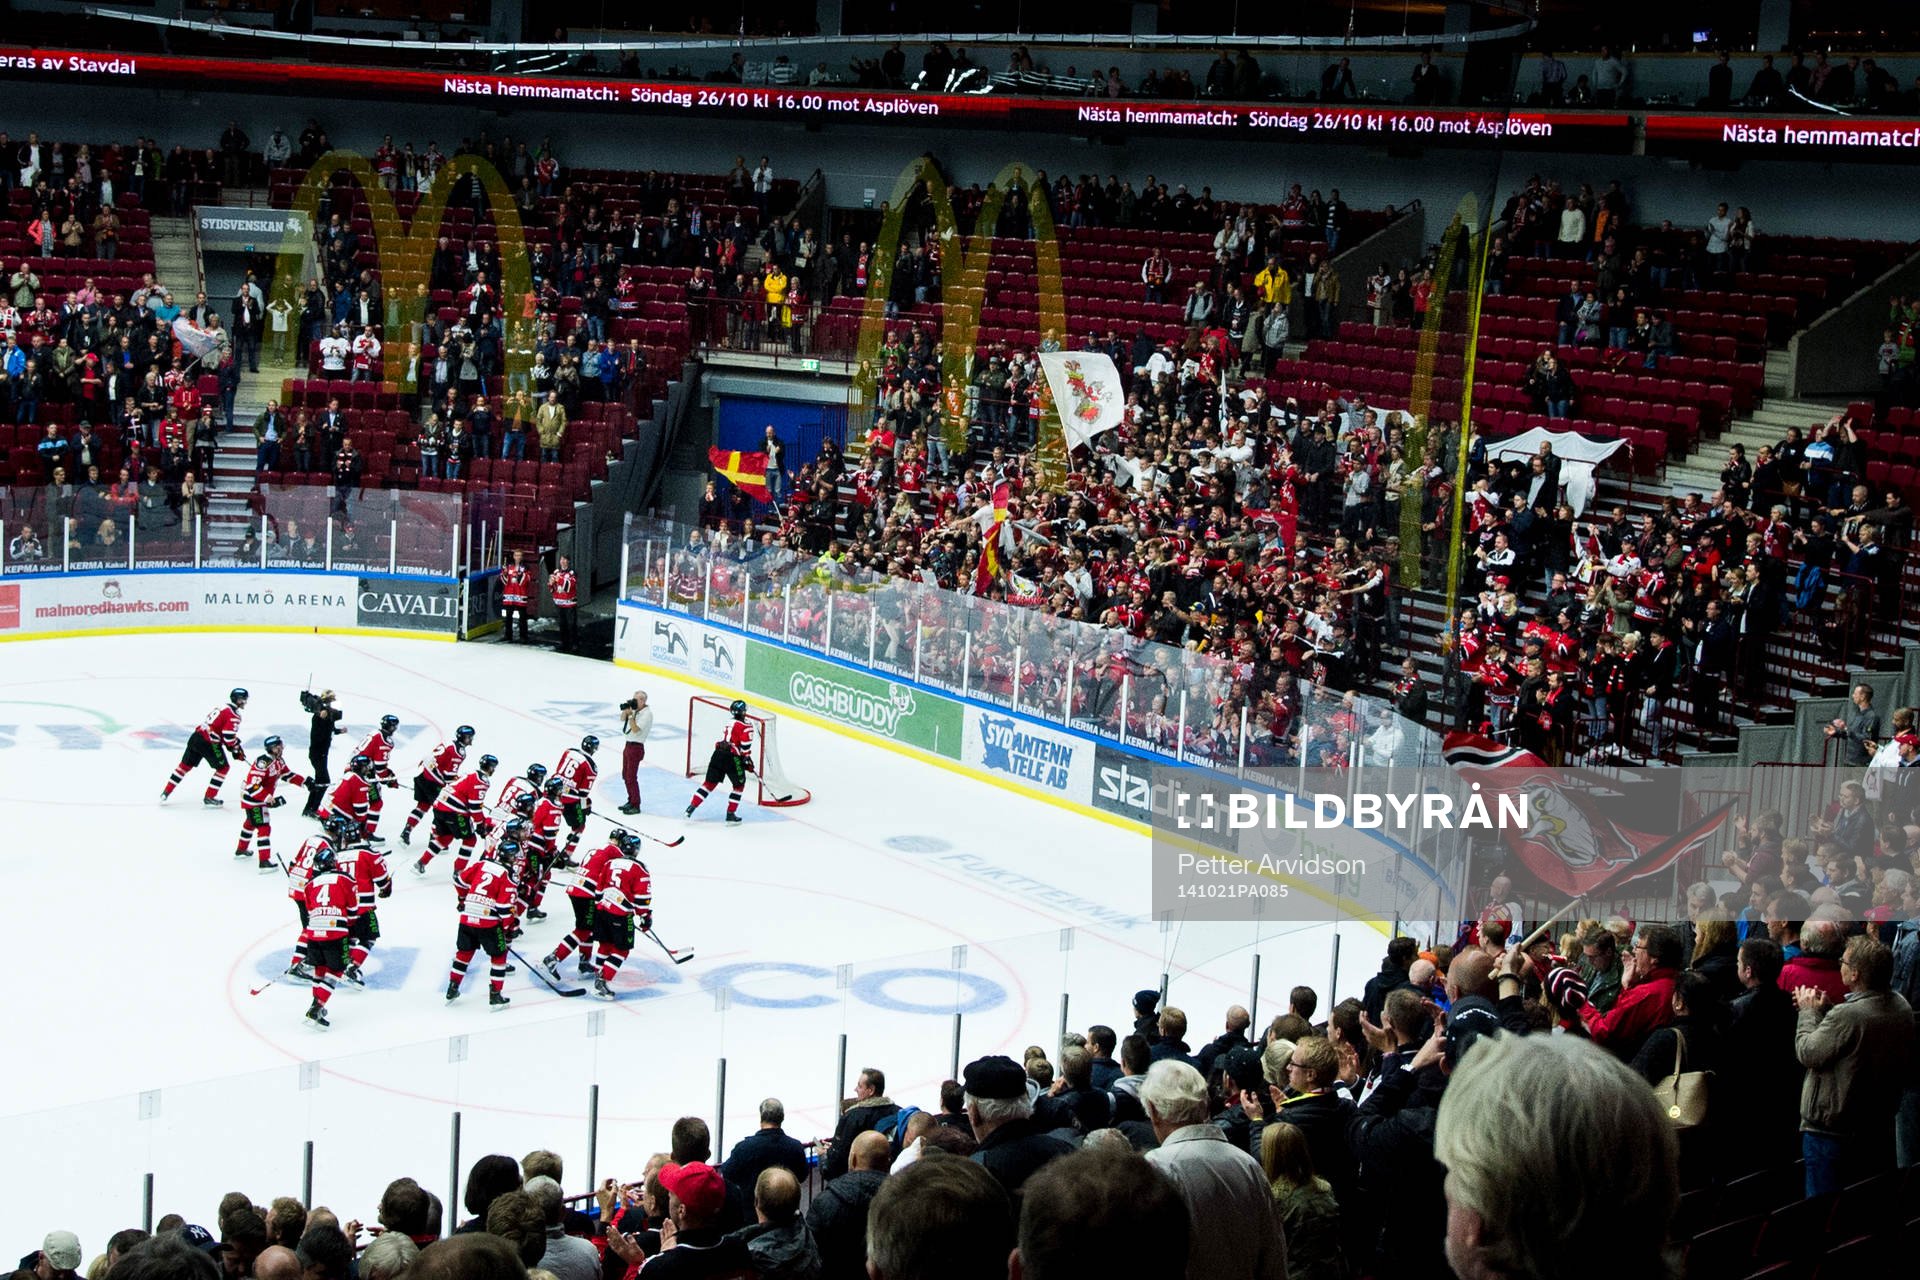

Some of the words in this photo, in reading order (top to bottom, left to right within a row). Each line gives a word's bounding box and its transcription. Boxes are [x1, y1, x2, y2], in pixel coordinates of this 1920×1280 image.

[41, 57, 64, 70] av
[69, 56, 136, 75] Stavdal
[444, 78, 492, 95] Nästa
[497, 81, 620, 101] hemmamatch:
[631, 87, 692, 107] Söndag
[698, 91, 749, 107] 26/10
[753, 93, 769, 108] kl
[776, 95, 823, 110] 16.00
[827, 98, 860, 112] mot
[864, 98, 939, 116] Asplöven
[1078, 106, 1121, 122] Nästa
[1125, 107, 1238, 126] hemmamatch:
[1249, 111, 1308, 132] Söndag
[1313, 112, 1362, 130] 26/10
[1367, 114, 1383, 131] kl
[1390, 116, 1435, 133] 16.00
[1439, 118, 1471, 134] mot
[1475, 116, 1552, 139] Asplöven
[1723, 124, 1777, 143] Nästa
[201, 217, 284, 233] SYDSVENSKAN
[69, 560, 103, 571] KERMA
[135, 560, 170, 570] KERMA
[201, 560, 236, 569] KERMA
[267, 560, 301, 569] KERMA
[332, 562, 366, 573] KERMA
[396, 565, 429, 576] KERMA
[205, 588, 275, 605] MALMÖ
[285, 594, 346, 608] ARENA
[35, 599, 190, 618] malmoredhawks.com
[617, 615, 630, 639] 7
[831, 648, 853, 662] KERMA
[874, 660, 898, 673] KERMA
[791, 677, 898, 731] CASHBUDDY
[968, 688, 993, 703] KERMA
[1018, 703, 1045, 718] KERMA
[1071, 720, 1099, 736] KERMA
[1125, 734, 1156, 752] KERMA
[560, 757, 581, 779] 16
[1183, 751, 1214, 768] KERMA
[1011, 753, 1045, 784] TELE
[1045, 768, 1069, 791] AB
[475, 872, 493, 896] 2
[609, 868, 622, 888] 5
[315, 883, 331, 907] 4
